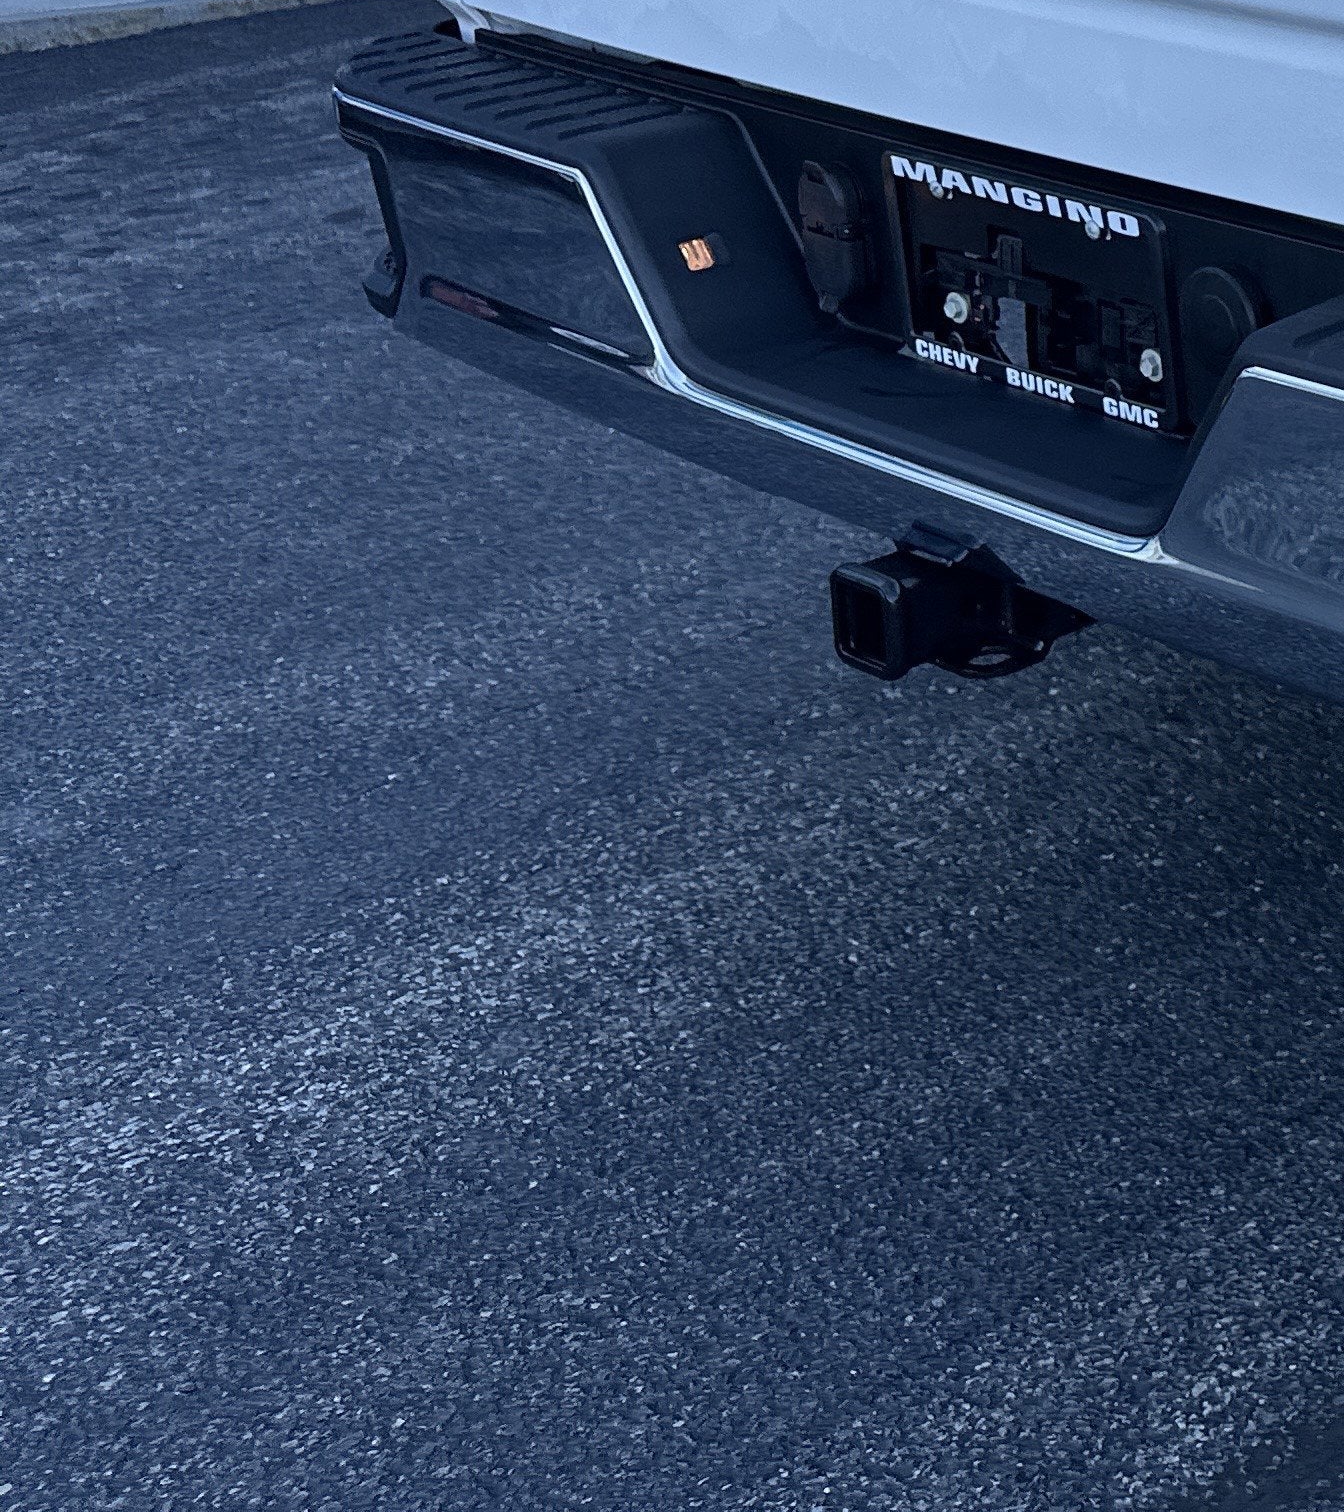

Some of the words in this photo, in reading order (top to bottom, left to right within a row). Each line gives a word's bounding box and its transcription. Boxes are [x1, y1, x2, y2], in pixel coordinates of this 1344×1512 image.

[890, 155, 1140, 238] MANGINO
[914, 338, 980, 374] CHEVY
[1005, 366, 1076, 404] BUICK
[1102, 396, 1160, 429] GMC
